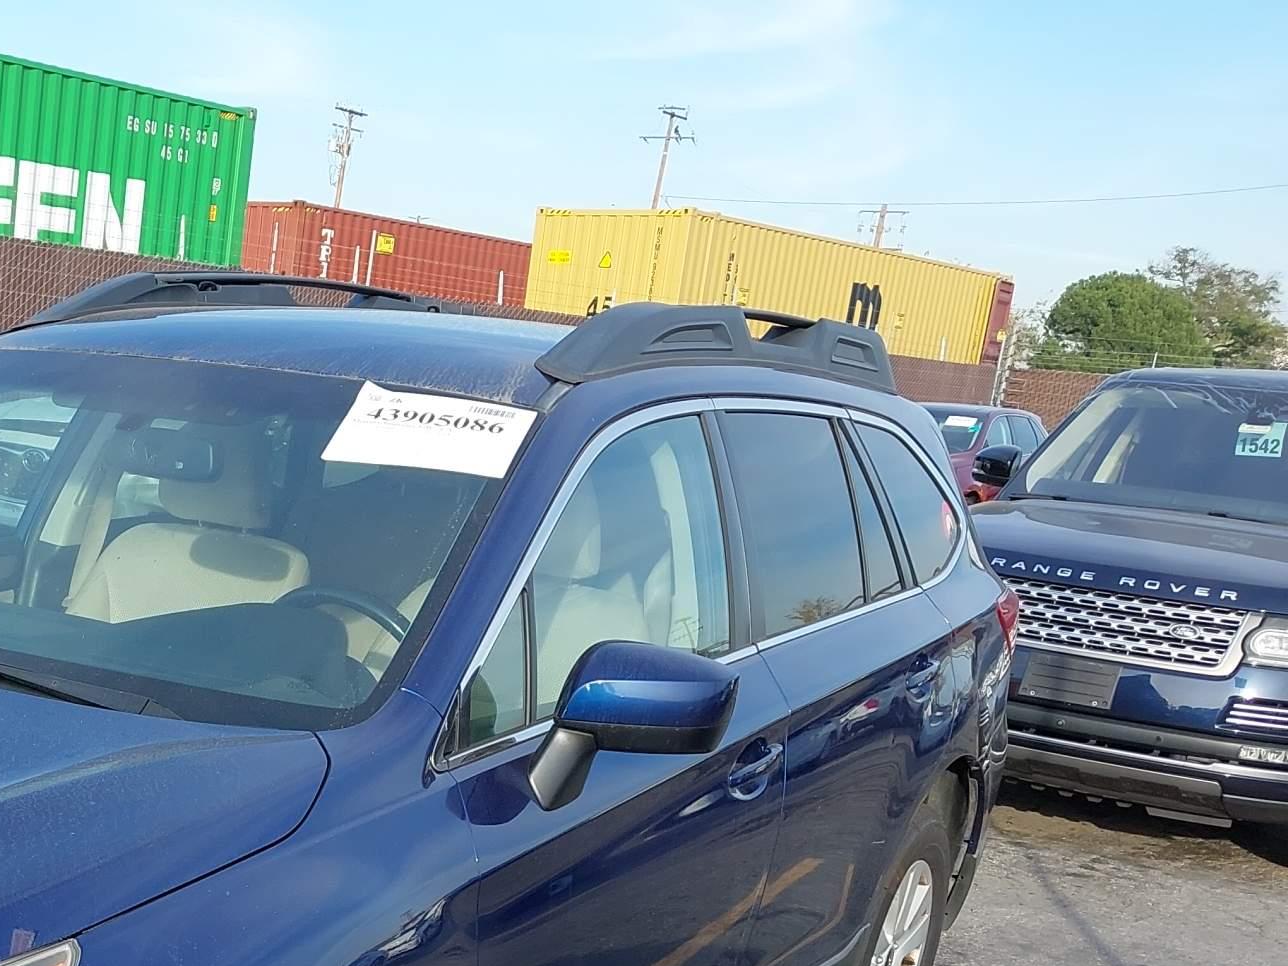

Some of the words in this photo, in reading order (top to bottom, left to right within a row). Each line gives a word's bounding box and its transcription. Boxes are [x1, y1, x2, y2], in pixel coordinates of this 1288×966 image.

[366, 407, 505, 434] 43905086
[1239, 437, 1280, 454] 1542
[990, 557, 1096, 581] RANGE
[1118, 576, 1239, 601] ROVER
